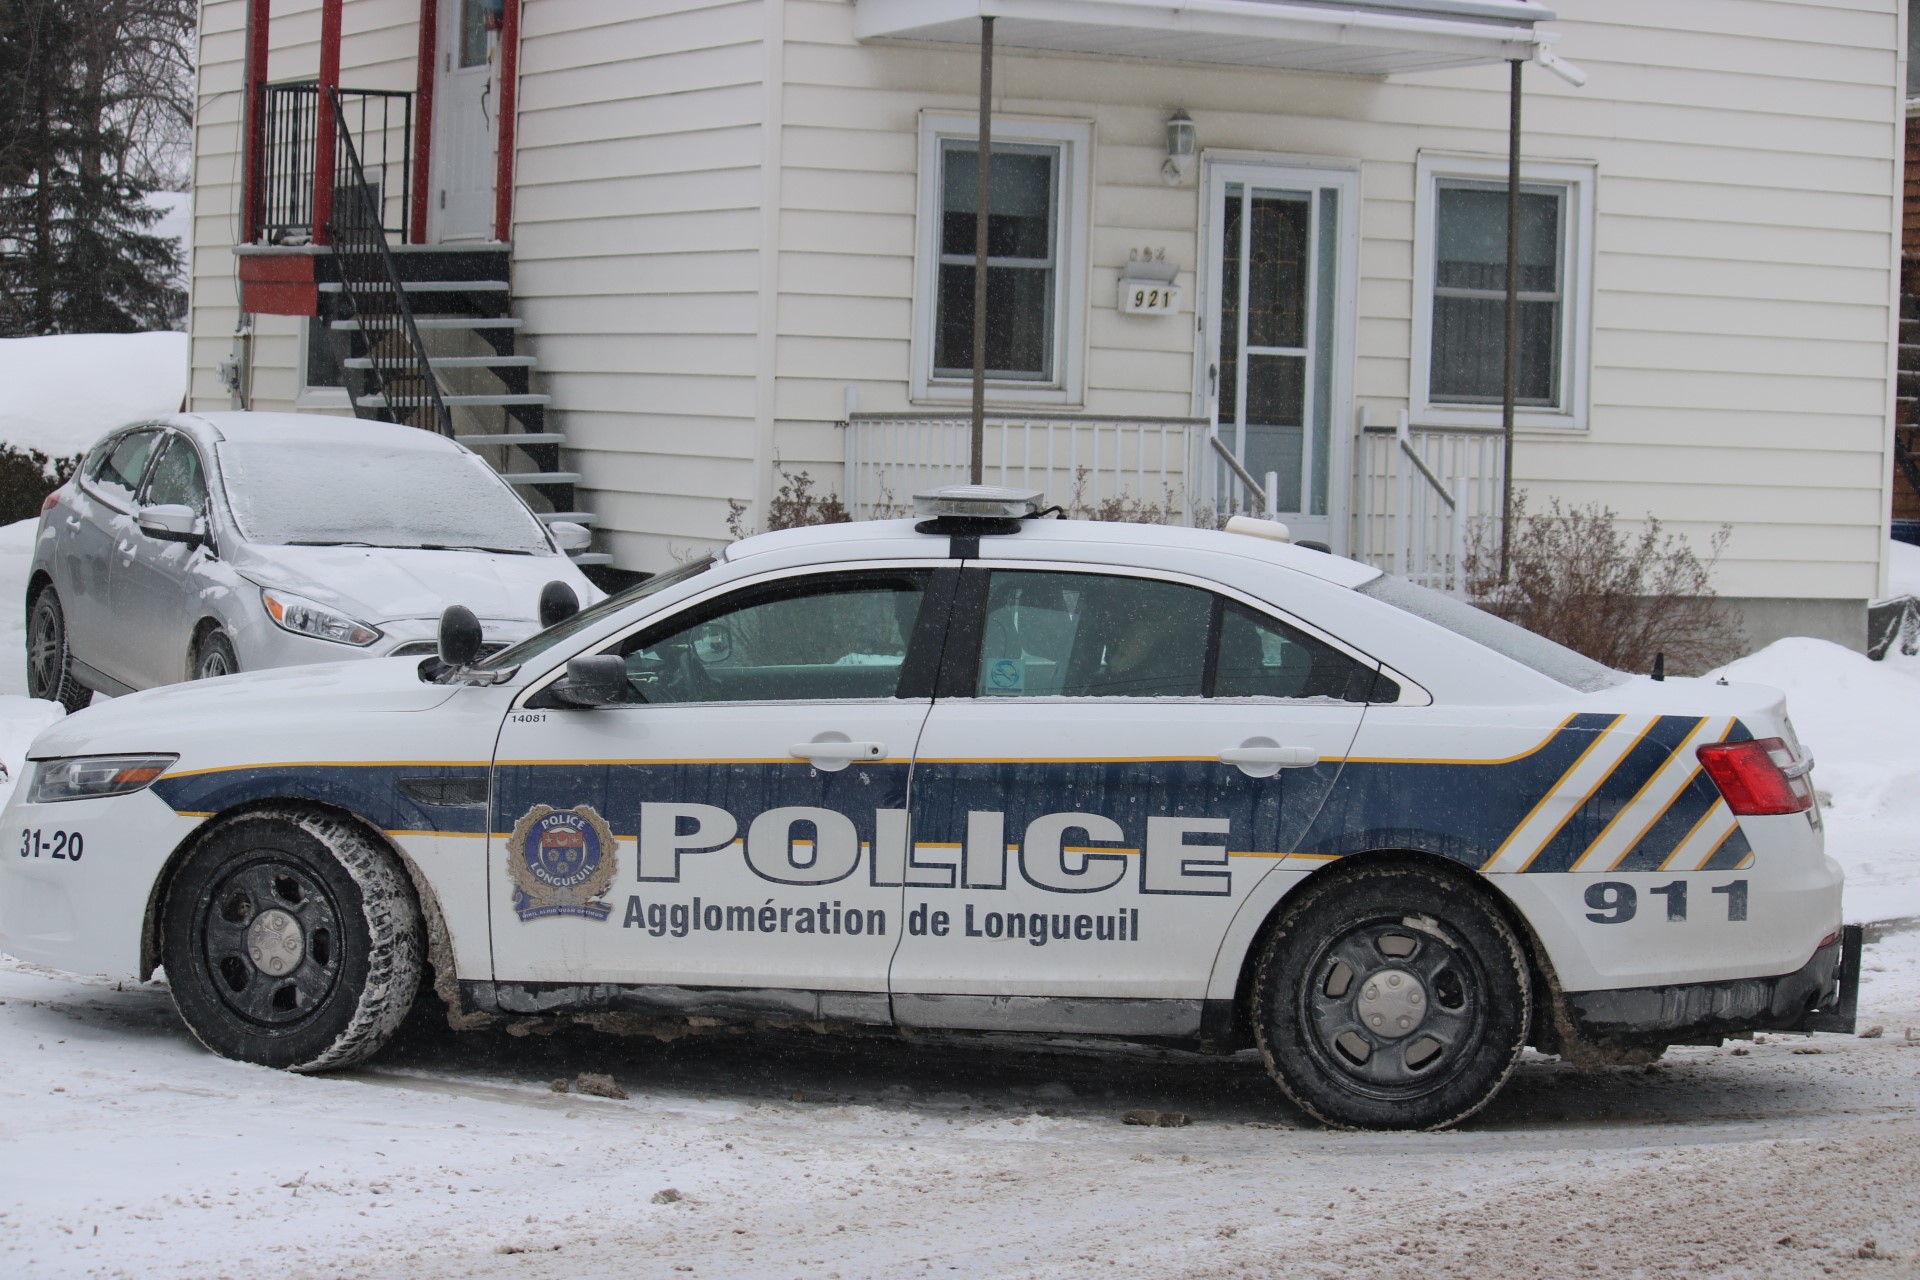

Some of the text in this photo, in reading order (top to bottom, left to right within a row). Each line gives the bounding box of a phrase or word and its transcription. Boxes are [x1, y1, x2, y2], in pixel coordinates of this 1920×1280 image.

[1134, 290, 1169, 308] 921
[512, 714, 547, 723] 14081
[541, 814, 586, 831] POLICE
[20, 828, 84, 862] 31-20
[637, 802, 1232, 897] POLICE
[530, 862, 595, 886] LONGUEUIL
[1584, 879, 1749, 924] 911
[623, 895, 1139, 947] Agglomération de Longueuil
